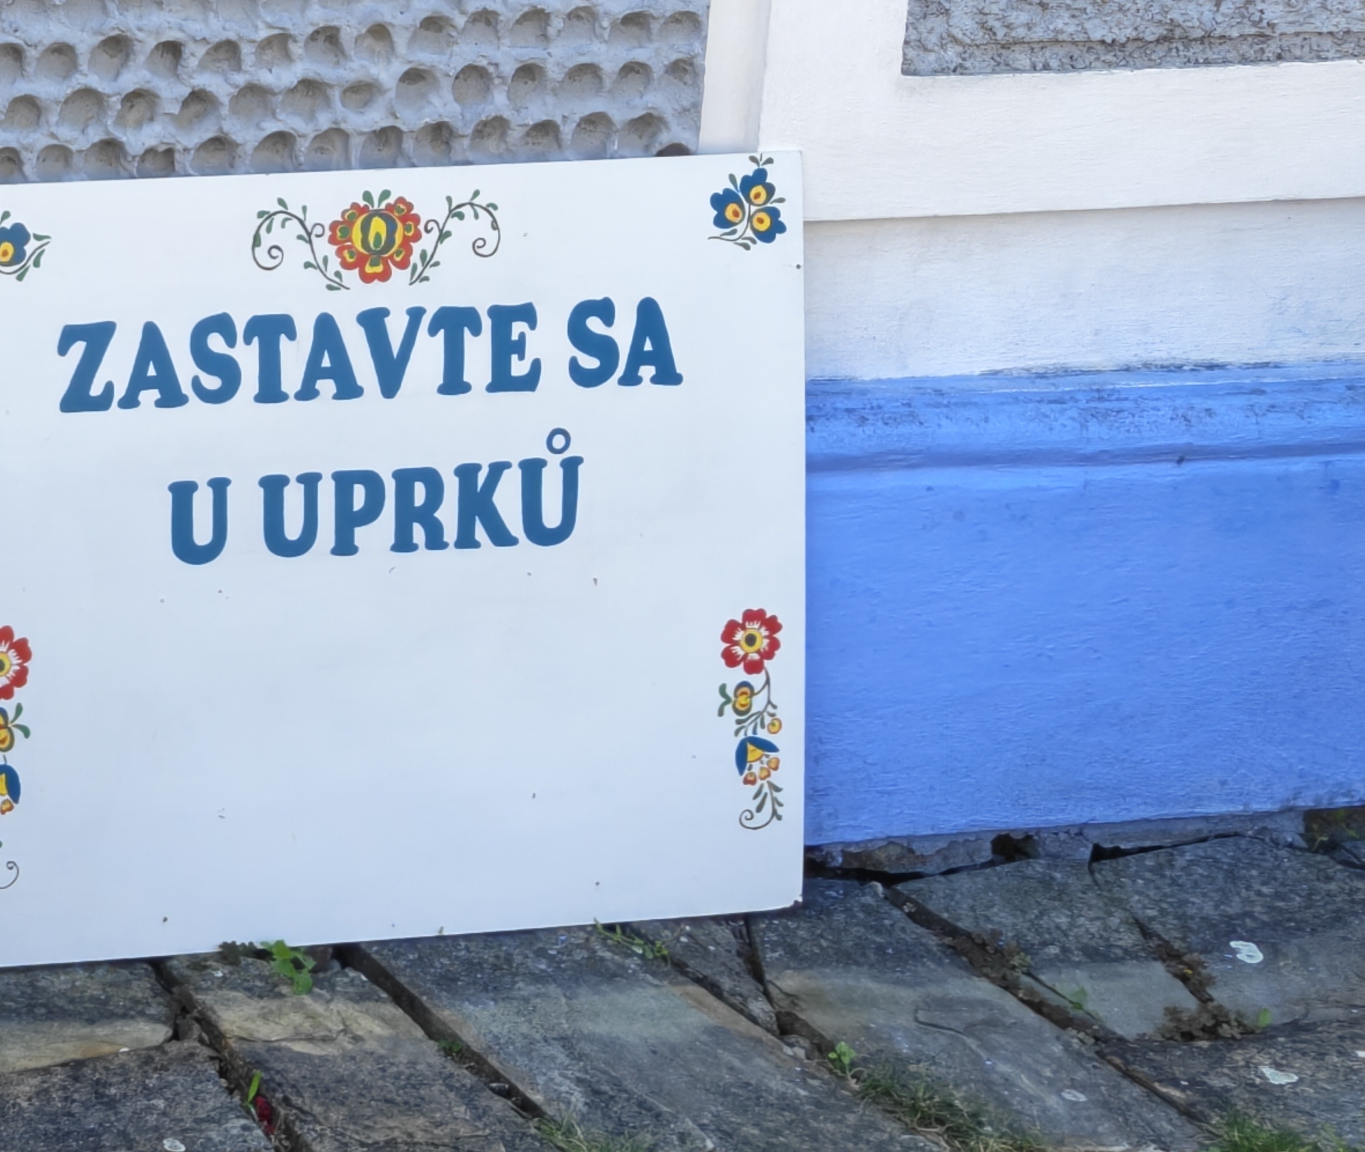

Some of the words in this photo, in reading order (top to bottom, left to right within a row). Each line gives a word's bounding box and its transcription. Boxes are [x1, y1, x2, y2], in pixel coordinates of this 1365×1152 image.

[57, 302, 542, 413] ZASTAVTE
[567, 296, 683, 389] SA
[167, 476, 232, 566] U
[258, 427, 584, 558] UPRKŮ
